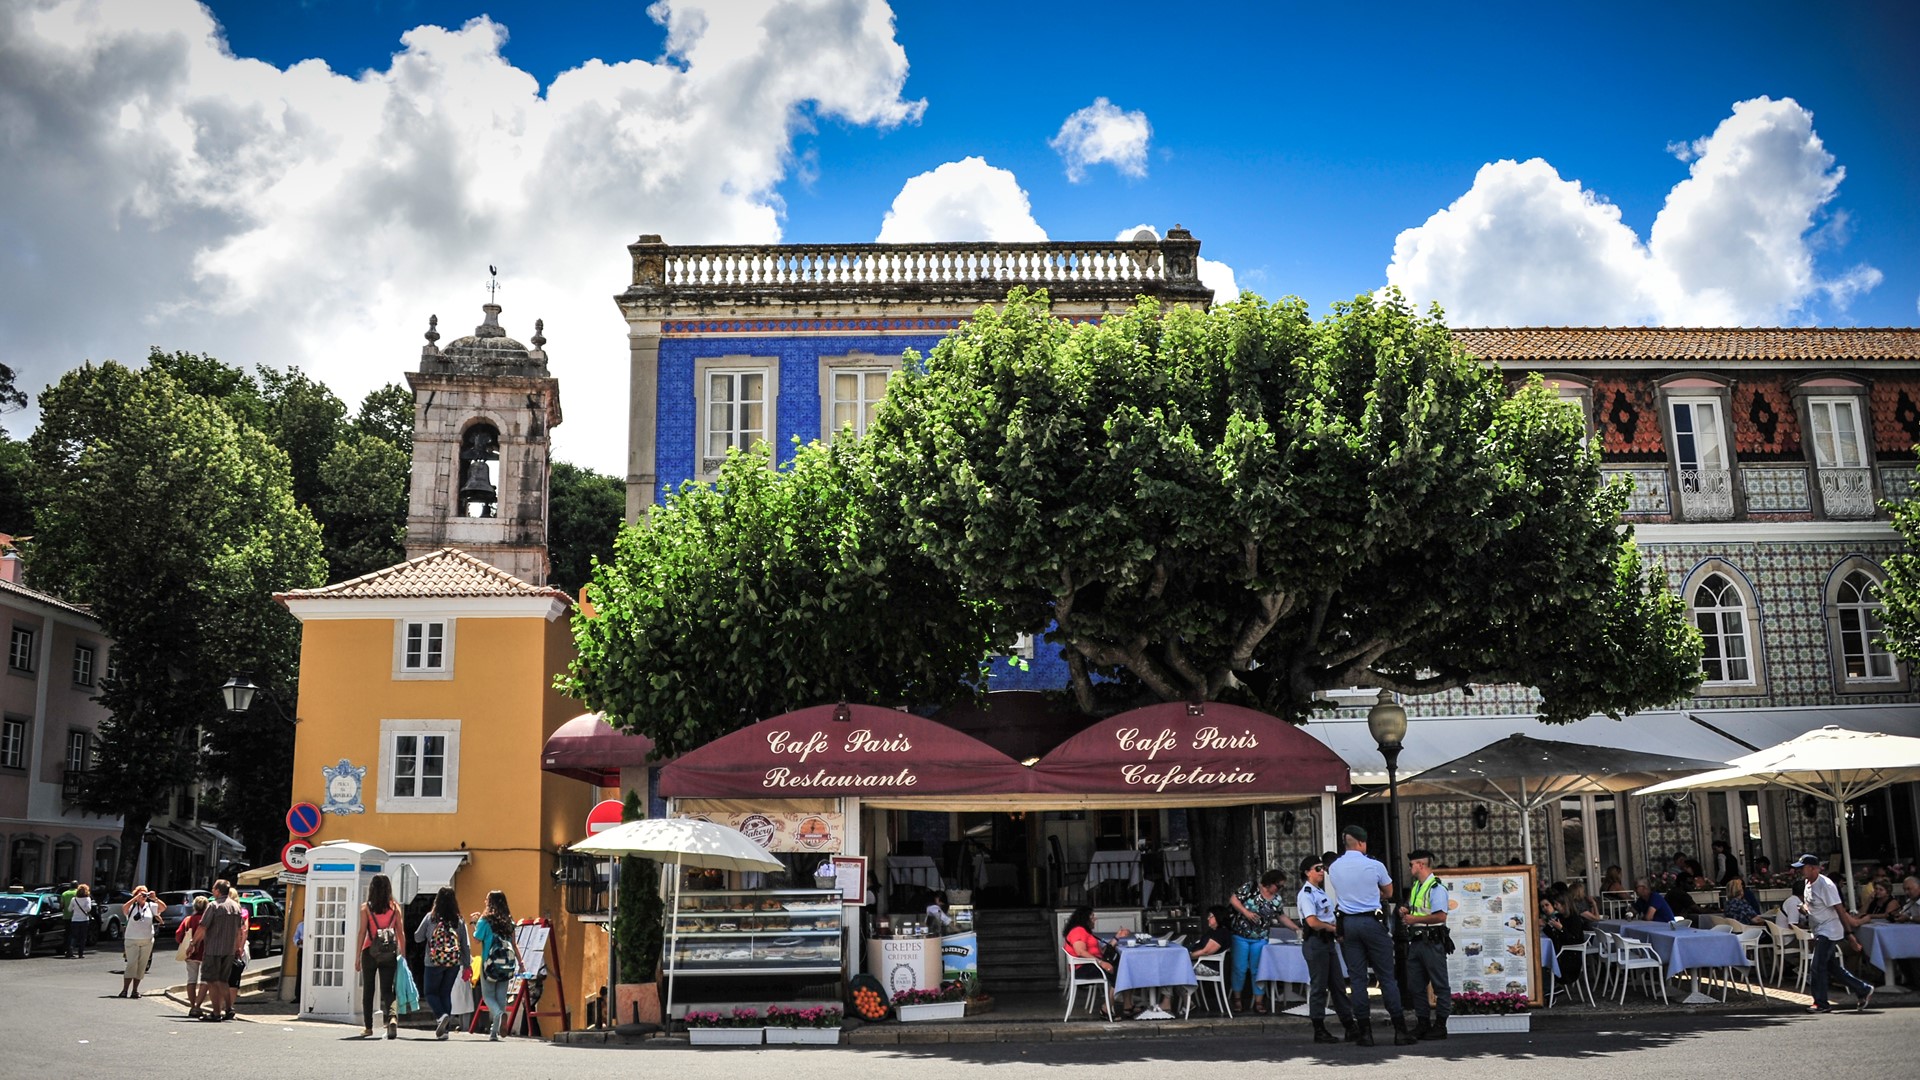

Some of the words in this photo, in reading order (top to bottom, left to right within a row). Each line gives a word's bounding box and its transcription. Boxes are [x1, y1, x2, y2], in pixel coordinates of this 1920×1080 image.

[767, 730, 828, 763] Café
[844, 729, 912, 753] Paris
[1116, 727, 1177, 760] Café
[1192, 726, 1259, 750] Paris
[763, 767, 917, 788] Restaurante
[1121, 764, 1256, 793] Cafetaria
[884, 942, 922, 952] CREPES
